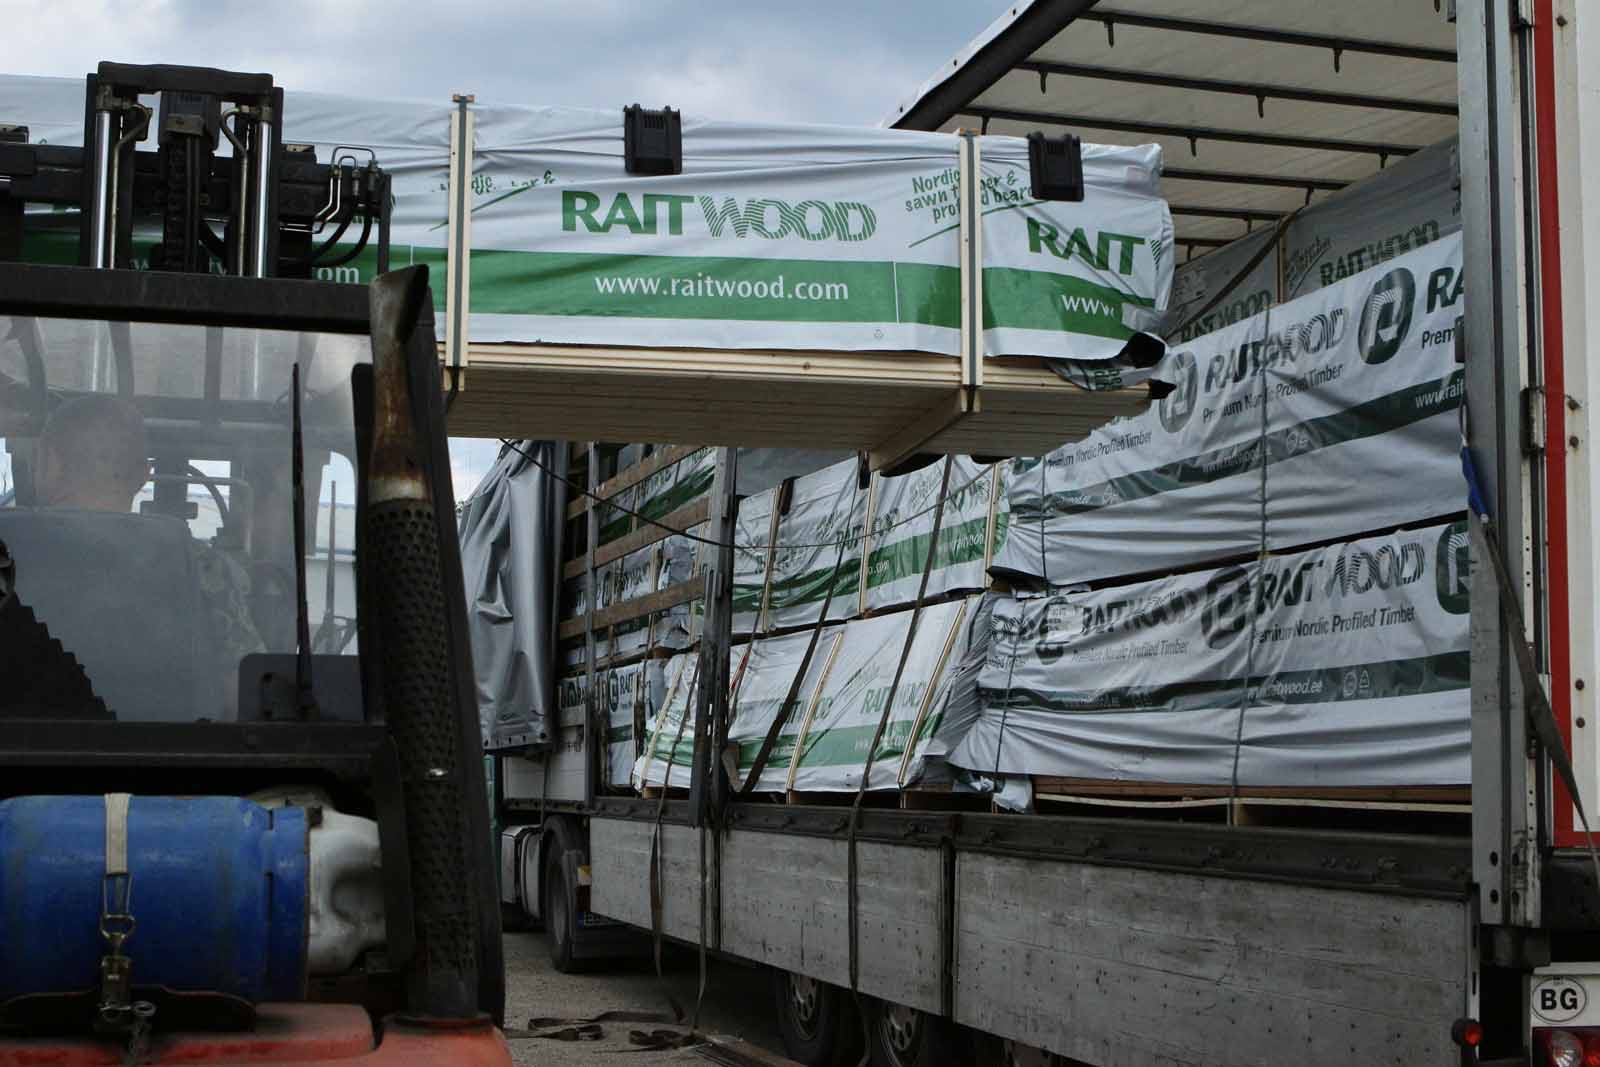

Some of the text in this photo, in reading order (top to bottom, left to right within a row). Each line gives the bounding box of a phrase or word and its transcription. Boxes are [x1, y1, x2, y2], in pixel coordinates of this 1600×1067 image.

[905, 190, 948, 212] sawn
[561, 190, 877, 242] RAITWOOD
[594, 272, 849, 301] www.raitwood.com
[1294, 616, 1329, 638] Nordic
[1331, 608, 1376, 634] Profiled
[1379, 605, 1416, 627] Timber
[1541, 988, 1578, 1011] BG
